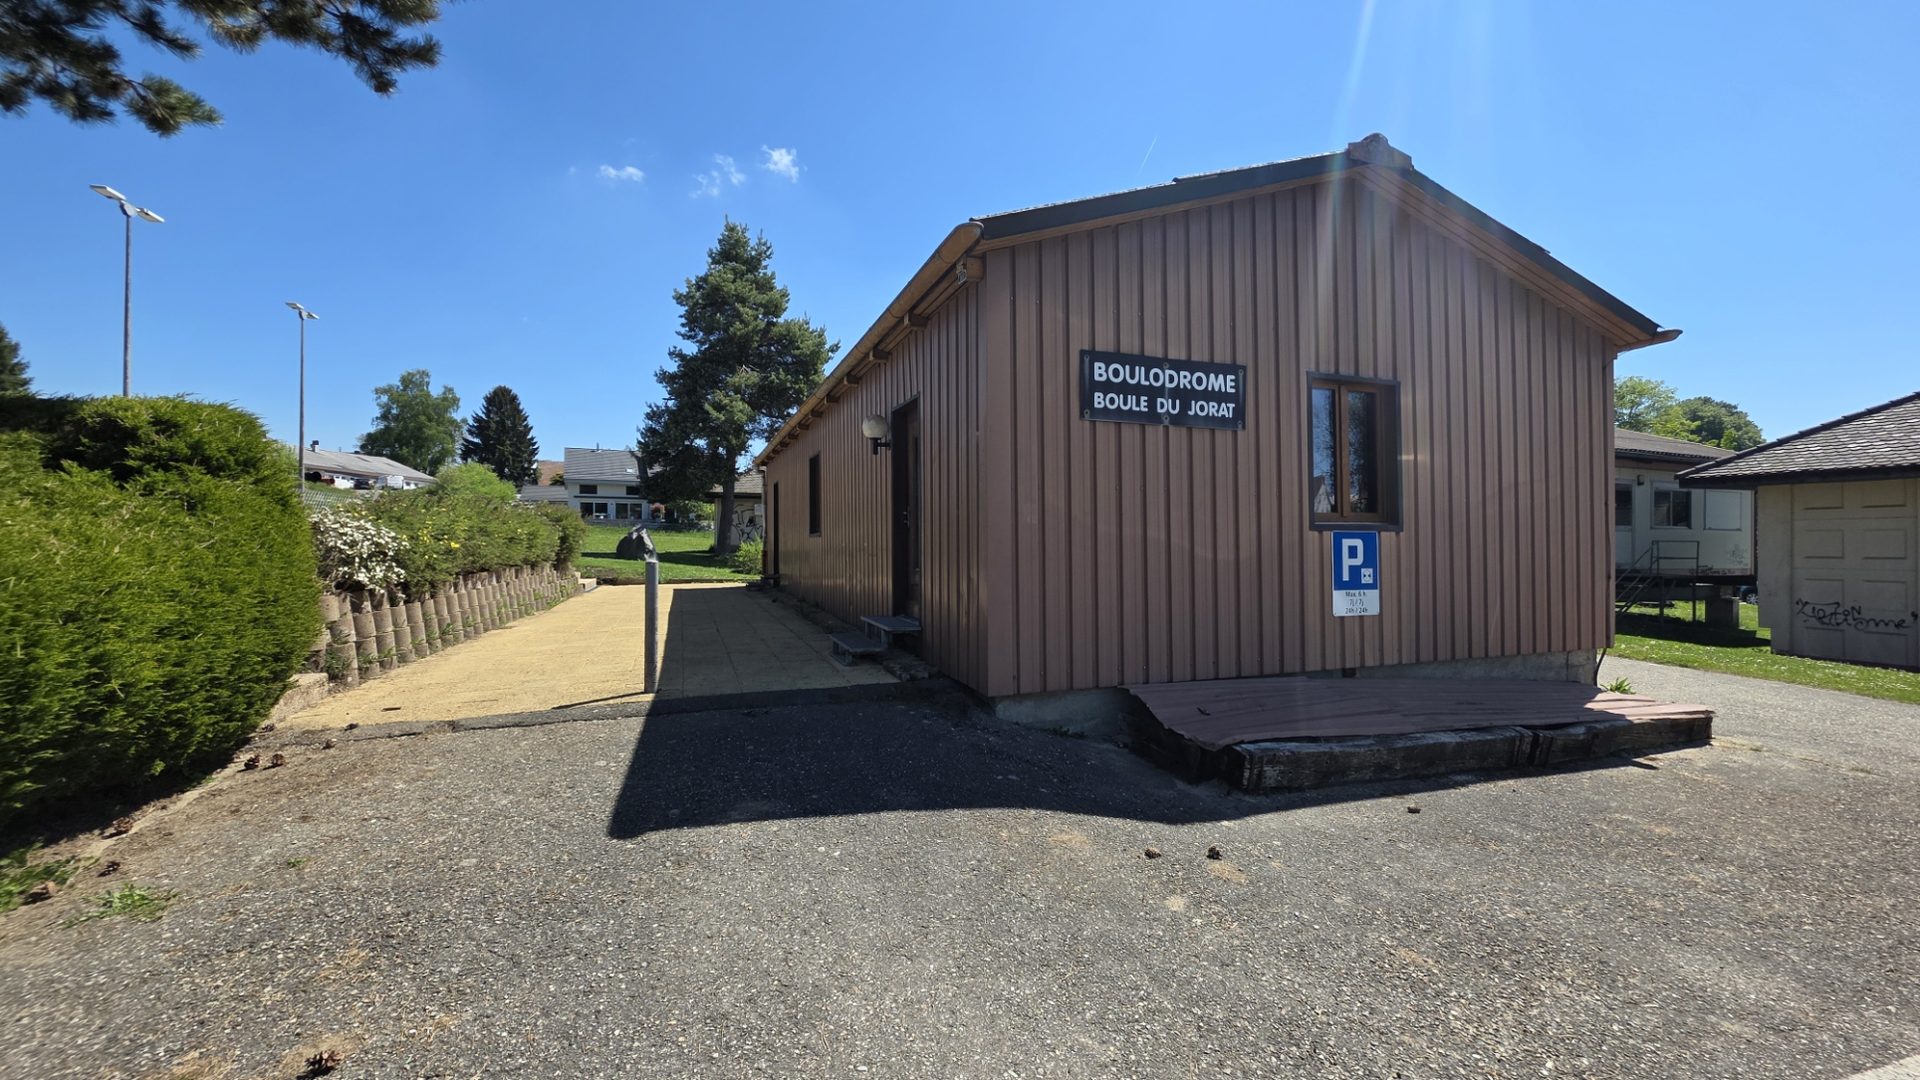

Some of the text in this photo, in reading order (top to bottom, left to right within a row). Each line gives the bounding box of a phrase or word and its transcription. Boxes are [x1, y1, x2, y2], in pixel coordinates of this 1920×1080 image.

[1093, 362, 1236, 393] BOULODROME
[1093, 392, 1236, 418] BOULE DU JORAT
[1342, 538, 1364, 581] P
